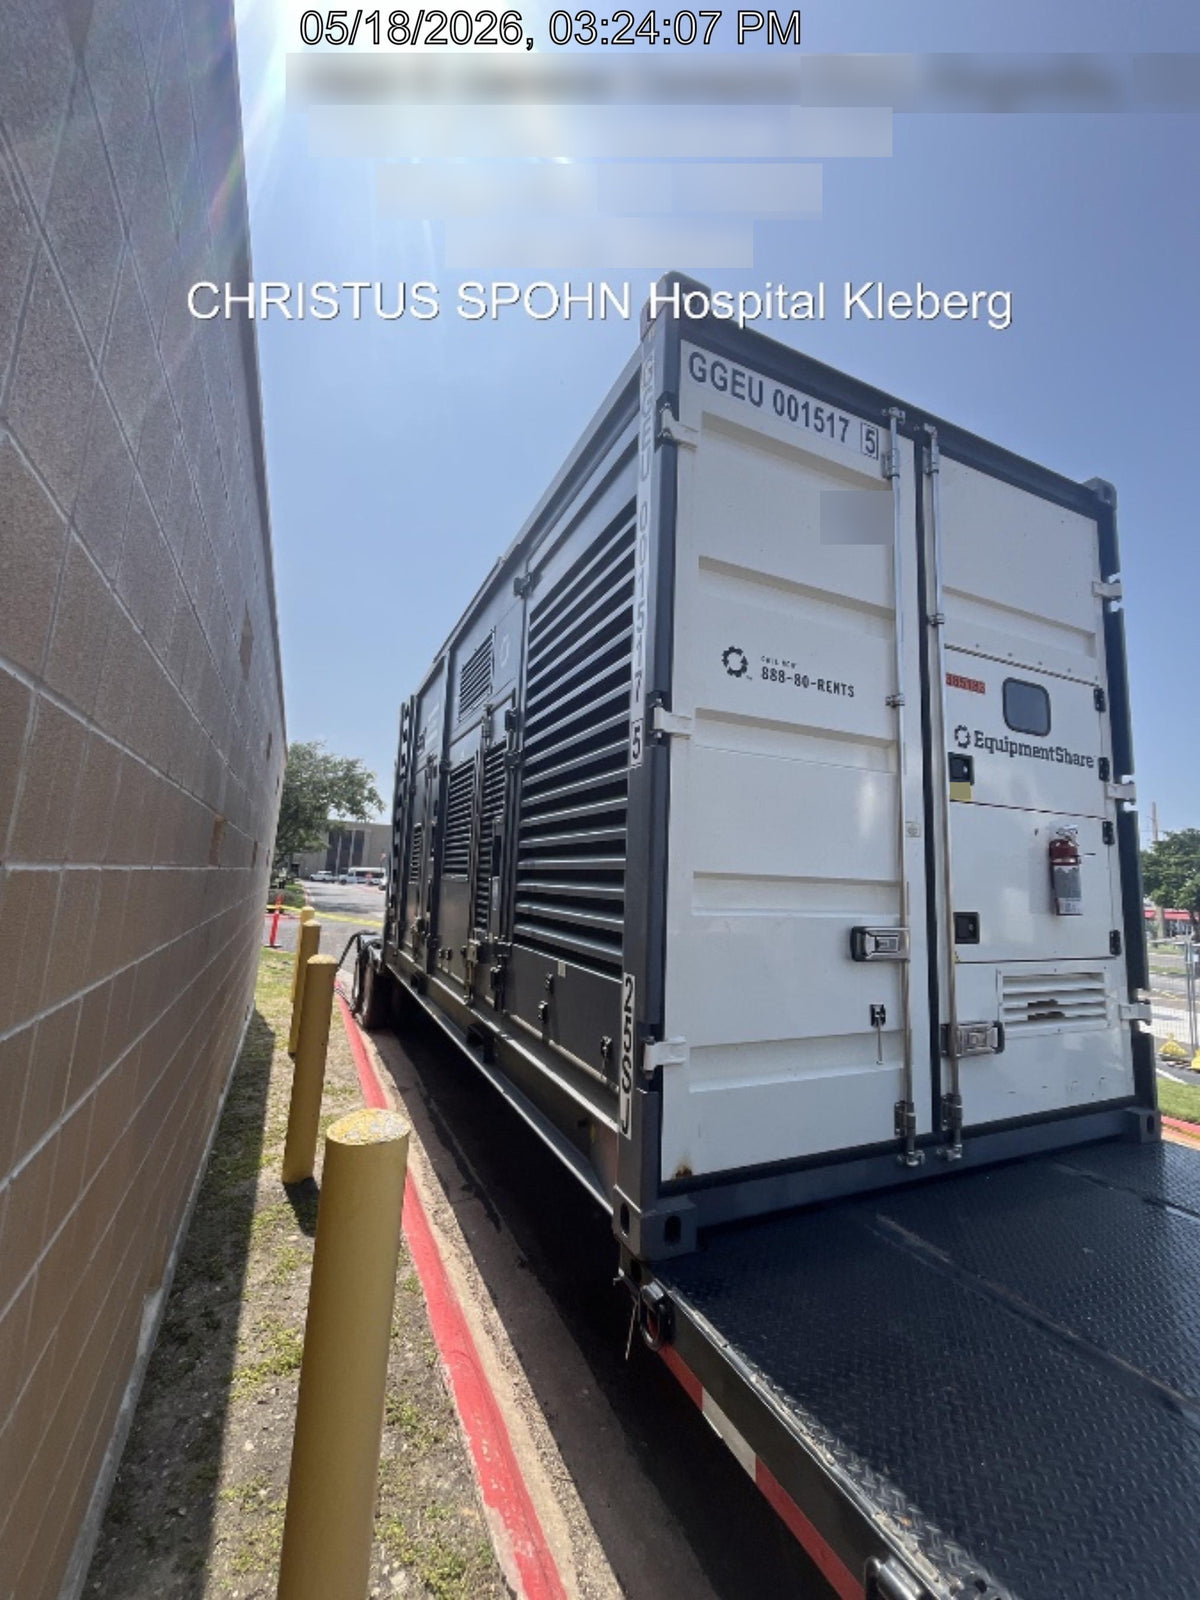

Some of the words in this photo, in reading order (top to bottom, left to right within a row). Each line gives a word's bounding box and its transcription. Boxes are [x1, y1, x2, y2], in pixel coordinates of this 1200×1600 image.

[688, 351, 764, 408] GGEU
[772, 388, 851, 443] 001517
[864, 427, 877, 455] 5
[761, 666, 855, 698] 888-80-RENTS
[973, 730, 1095, 769] EquipmentShare
